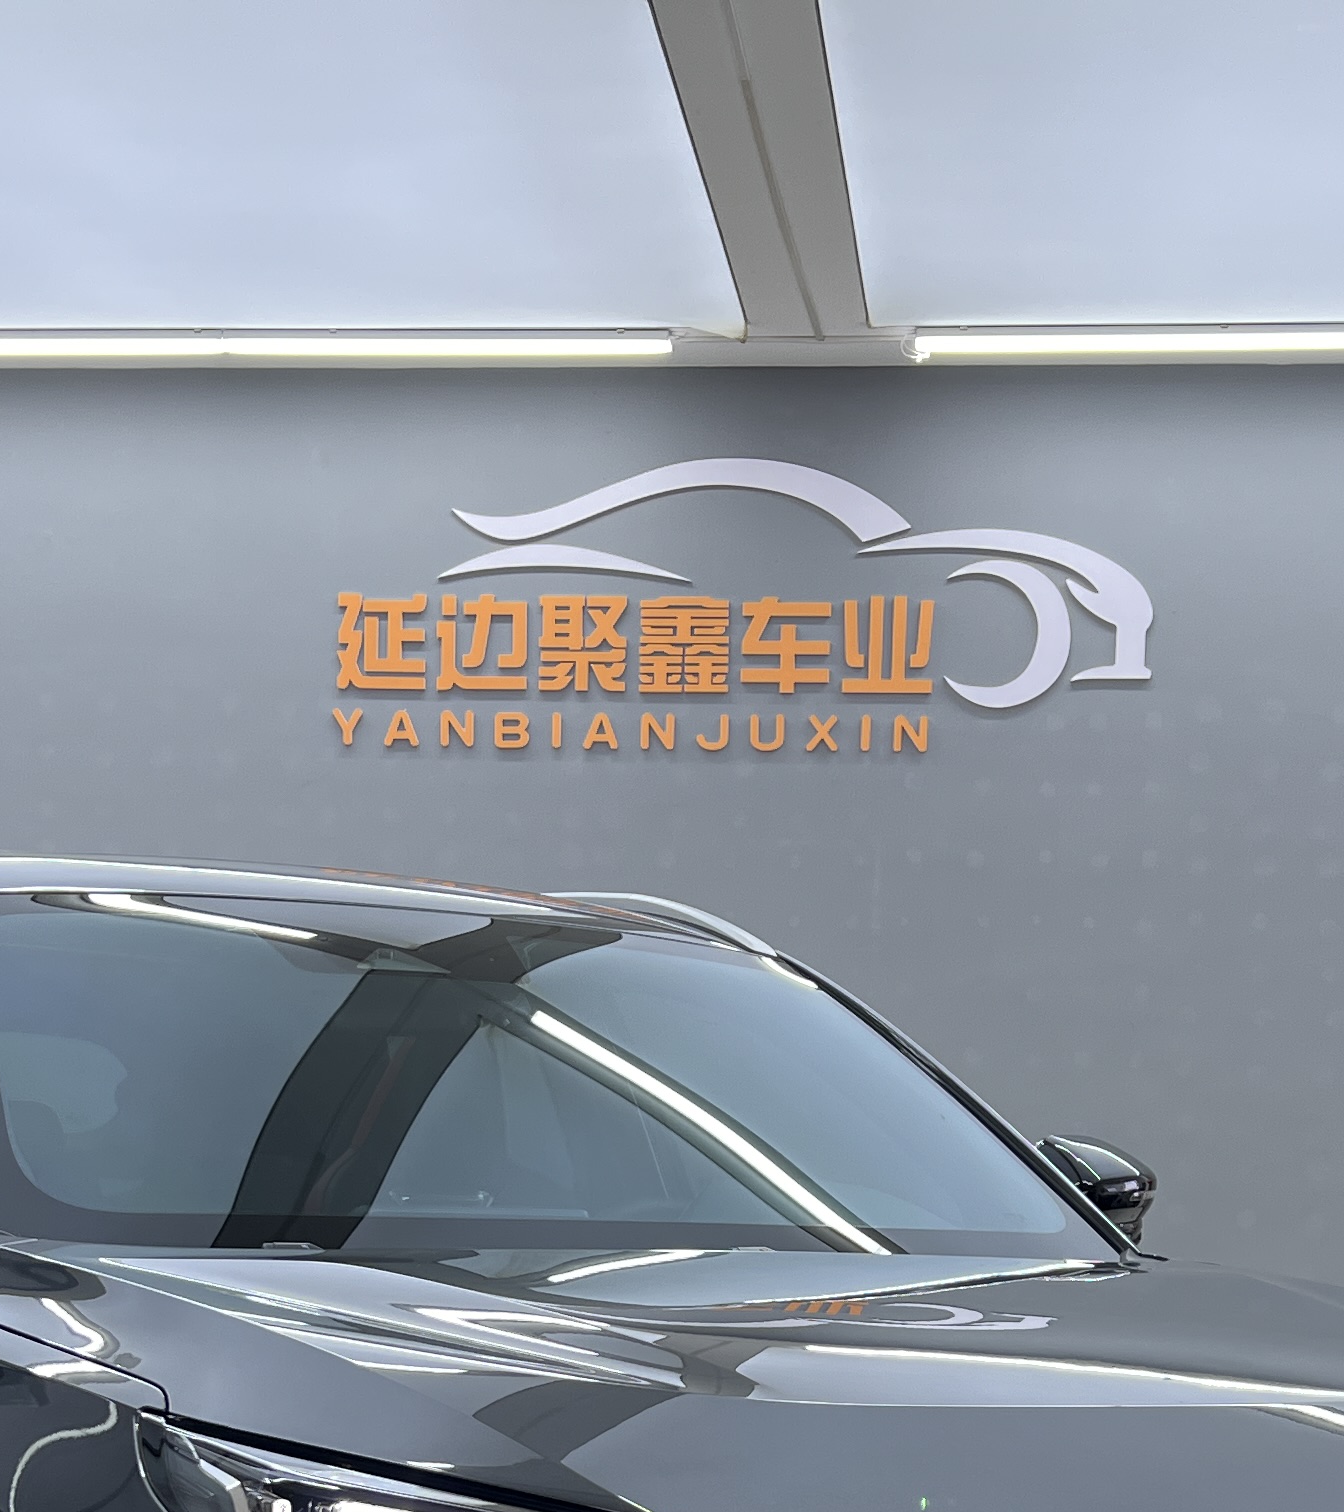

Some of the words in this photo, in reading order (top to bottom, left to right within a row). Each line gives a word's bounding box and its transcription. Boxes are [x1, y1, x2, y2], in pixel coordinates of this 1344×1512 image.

[336, 593, 934, 694] 延边聚鑫车业
[333, 708, 929, 753] YANBIANJUXIN
